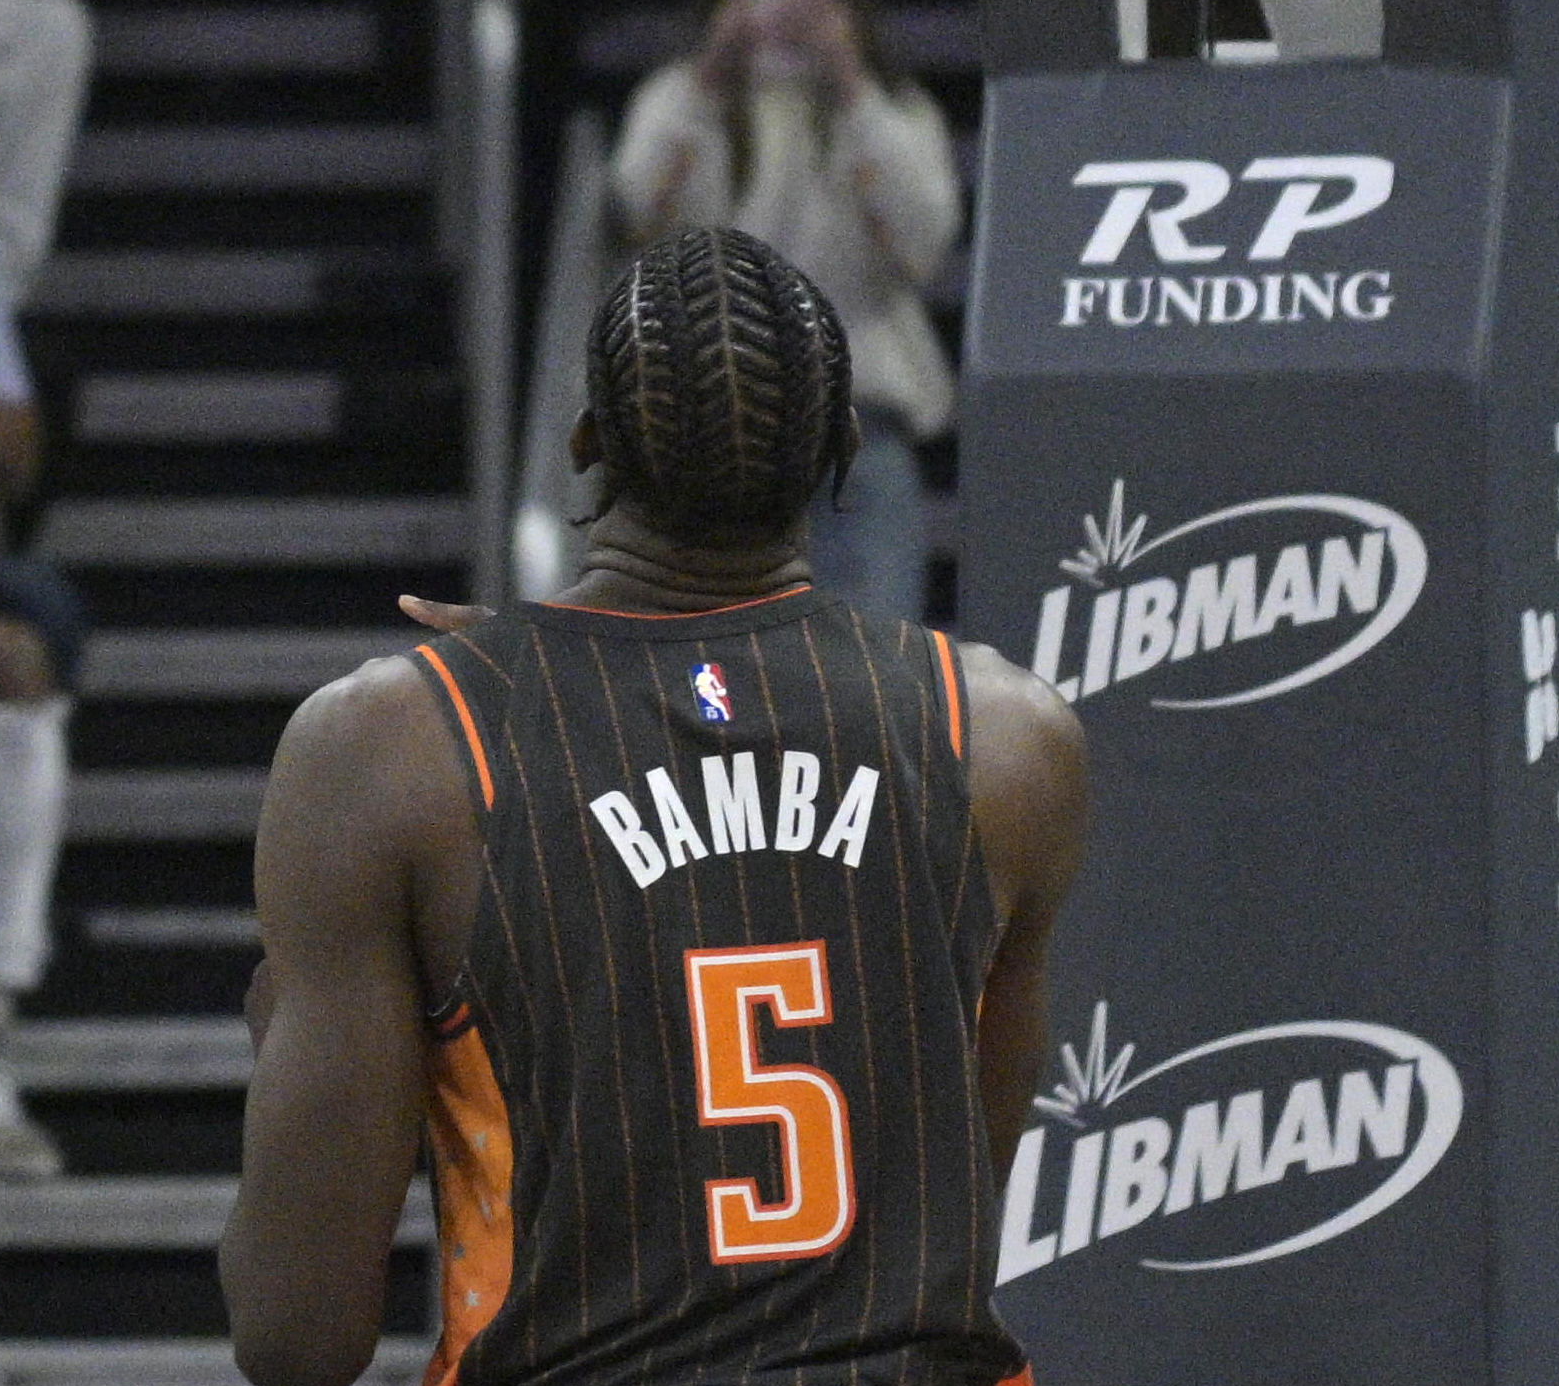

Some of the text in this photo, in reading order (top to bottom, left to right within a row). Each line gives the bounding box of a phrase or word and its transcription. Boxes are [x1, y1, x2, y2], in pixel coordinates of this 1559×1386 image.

[1072, 154, 1394, 265] RP
[1058, 270, 1393, 329] FUNDING
[1032, 525, 1388, 703] LIBMAN
[589, 750, 880, 890] BAMBA
[684, 939, 856, 1265] 5
[997, 1061, 1418, 1285] LIBMAN
